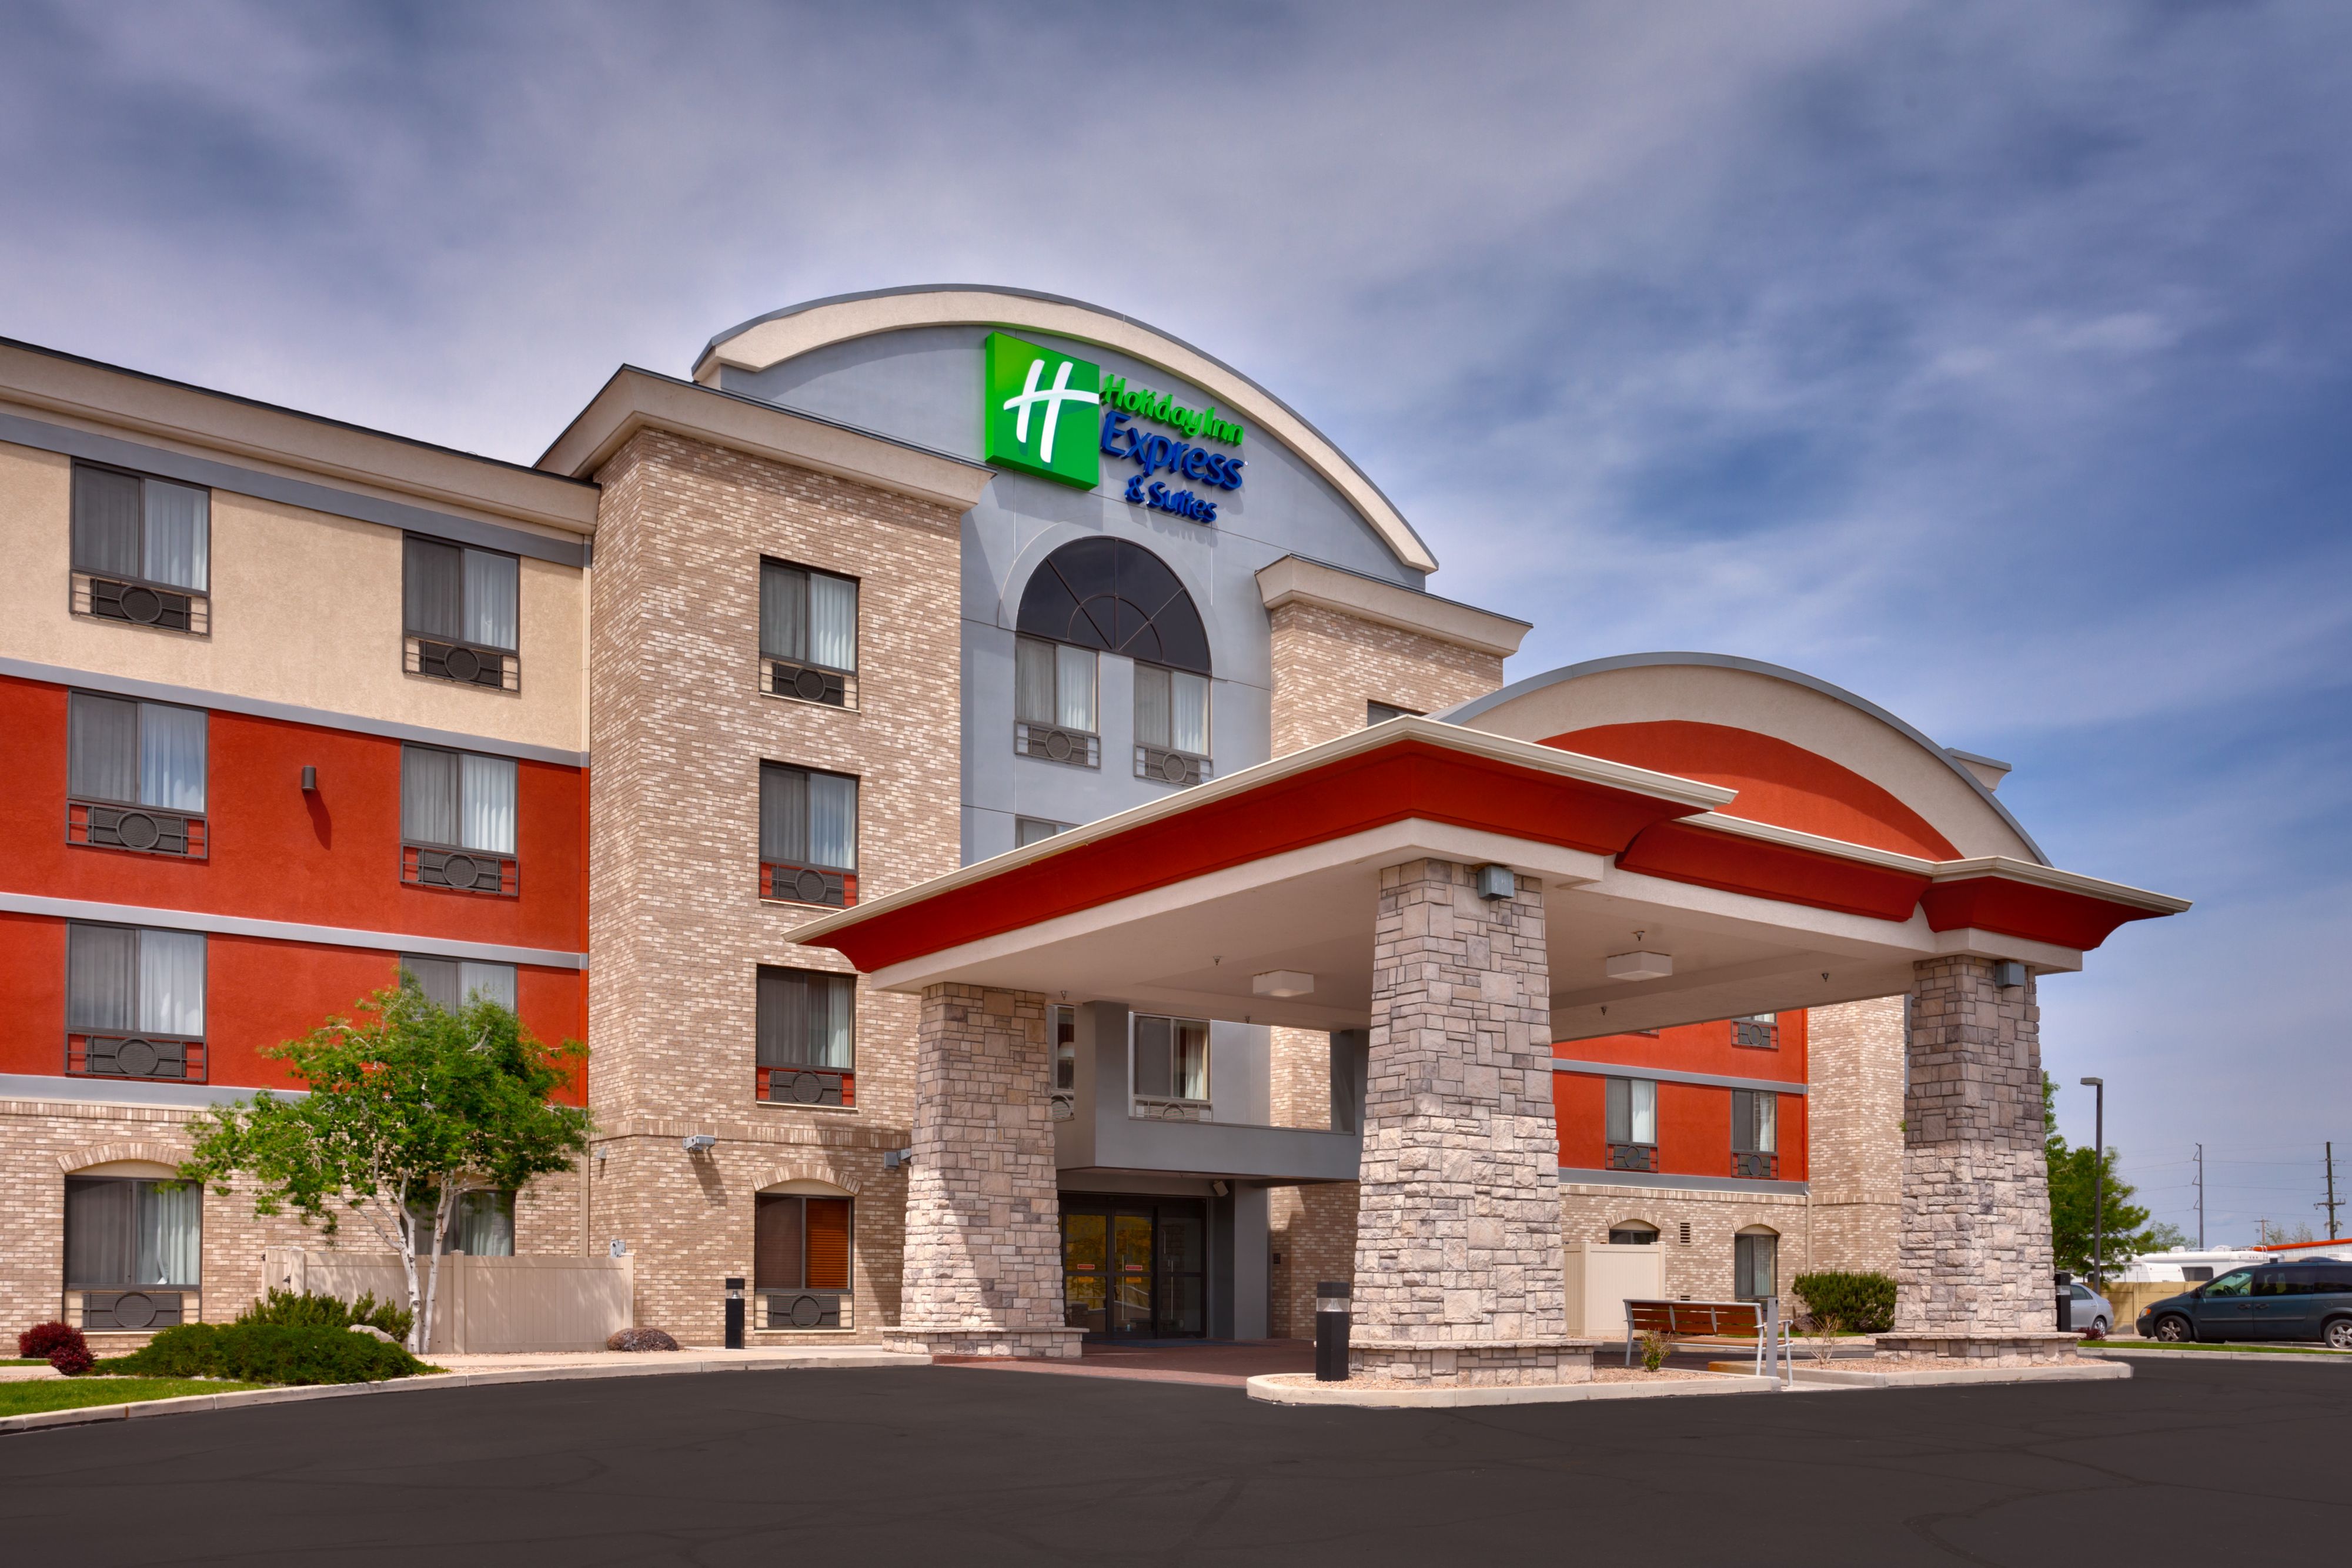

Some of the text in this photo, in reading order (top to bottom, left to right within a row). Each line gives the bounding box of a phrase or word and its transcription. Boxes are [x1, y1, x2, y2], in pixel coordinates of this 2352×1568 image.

[1100, 373, 1244, 446] Holiday Inn
[1101, 410, 1244, 490] Express
[1124, 475, 1217, 523] & Suites
